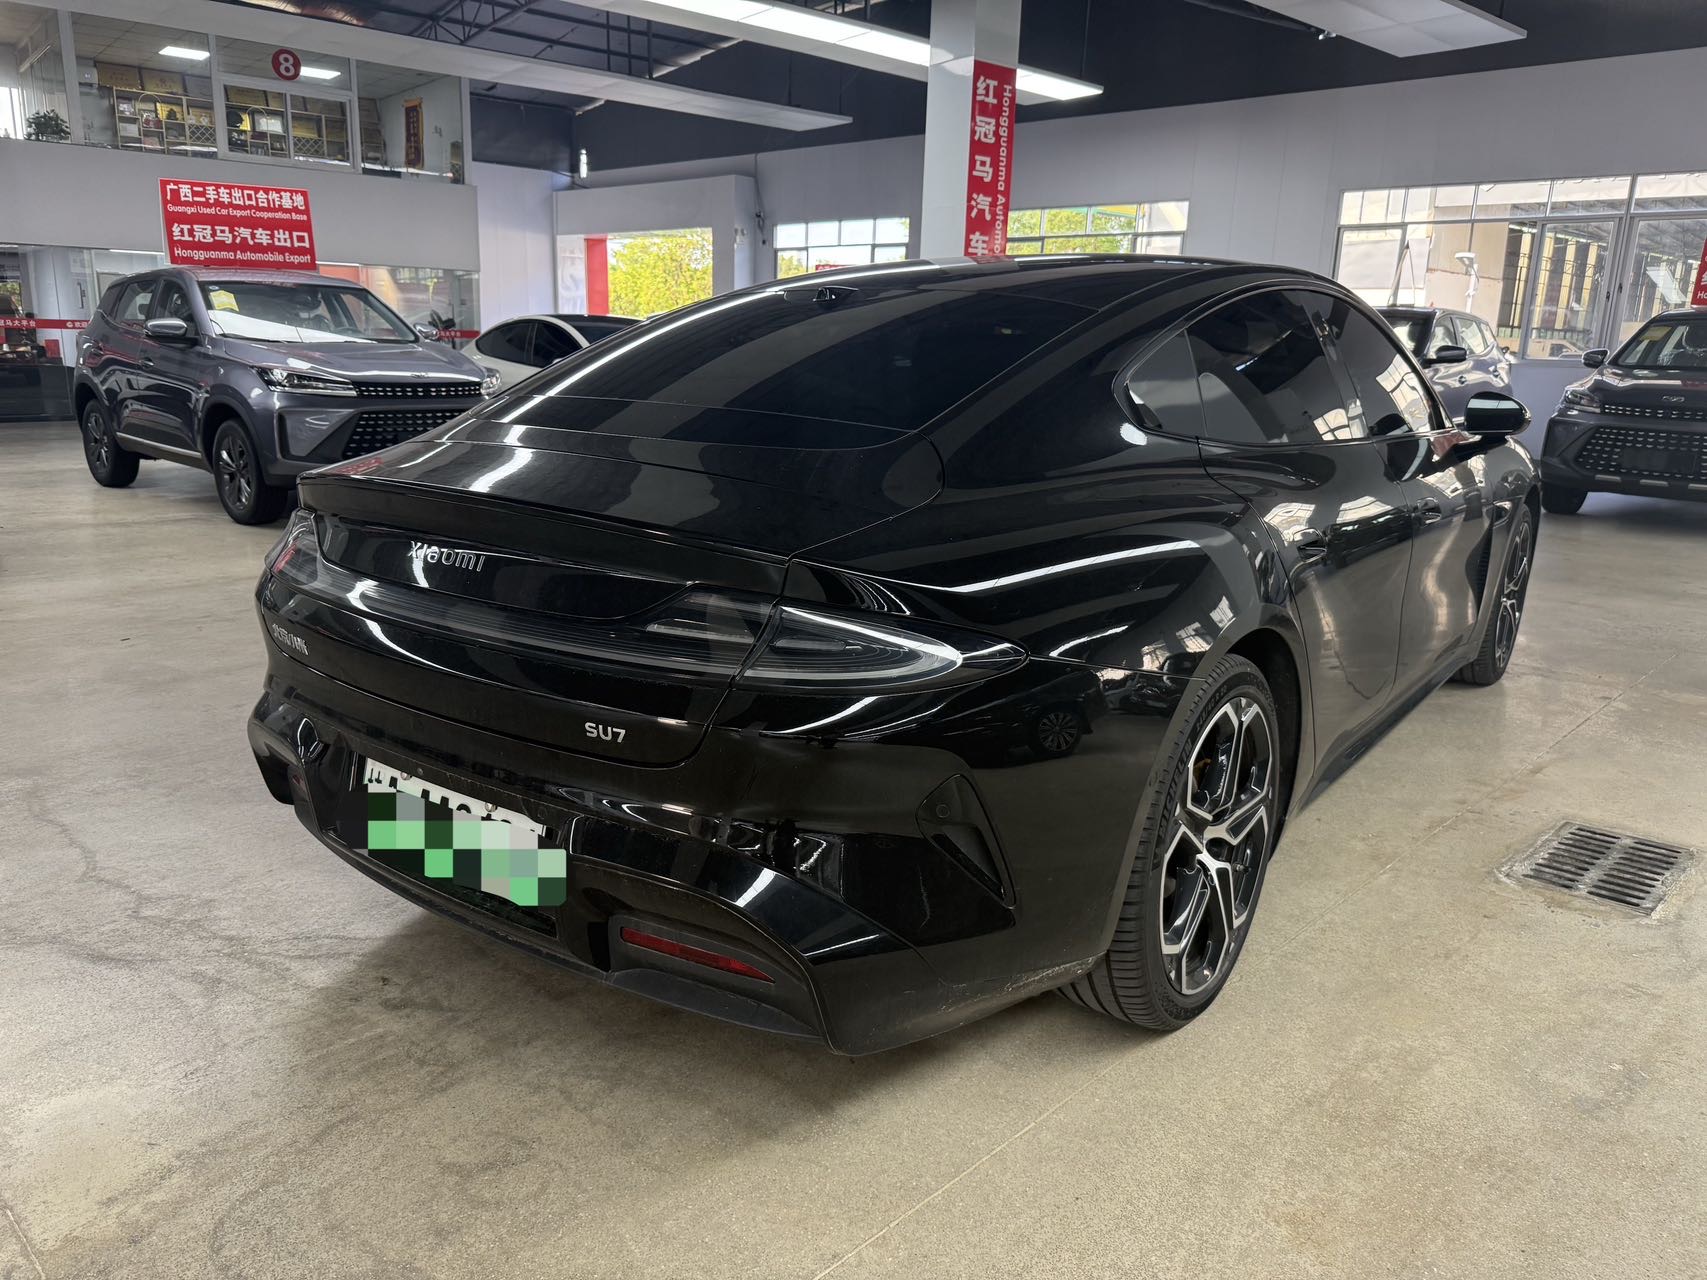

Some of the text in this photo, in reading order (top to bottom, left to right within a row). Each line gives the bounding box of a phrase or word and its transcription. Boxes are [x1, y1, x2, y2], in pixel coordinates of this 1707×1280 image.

[278, 53, 295, 76] 8
[968, 76, 998, 256] 红冠马汽车
[993, 84, 1012, 255] Hongguanma Automo
[166, 183, 305, 210] 广西二手车出口合作基地
[167, 203, 307, 221] Guangxi Used Car Export Cooperation Base
[171, 222, 310, 249] 红冠马汽车出口
[174, 247, 311, 264] Hongguanma Automobile Export
[584, 721, 626, 743] SU7
